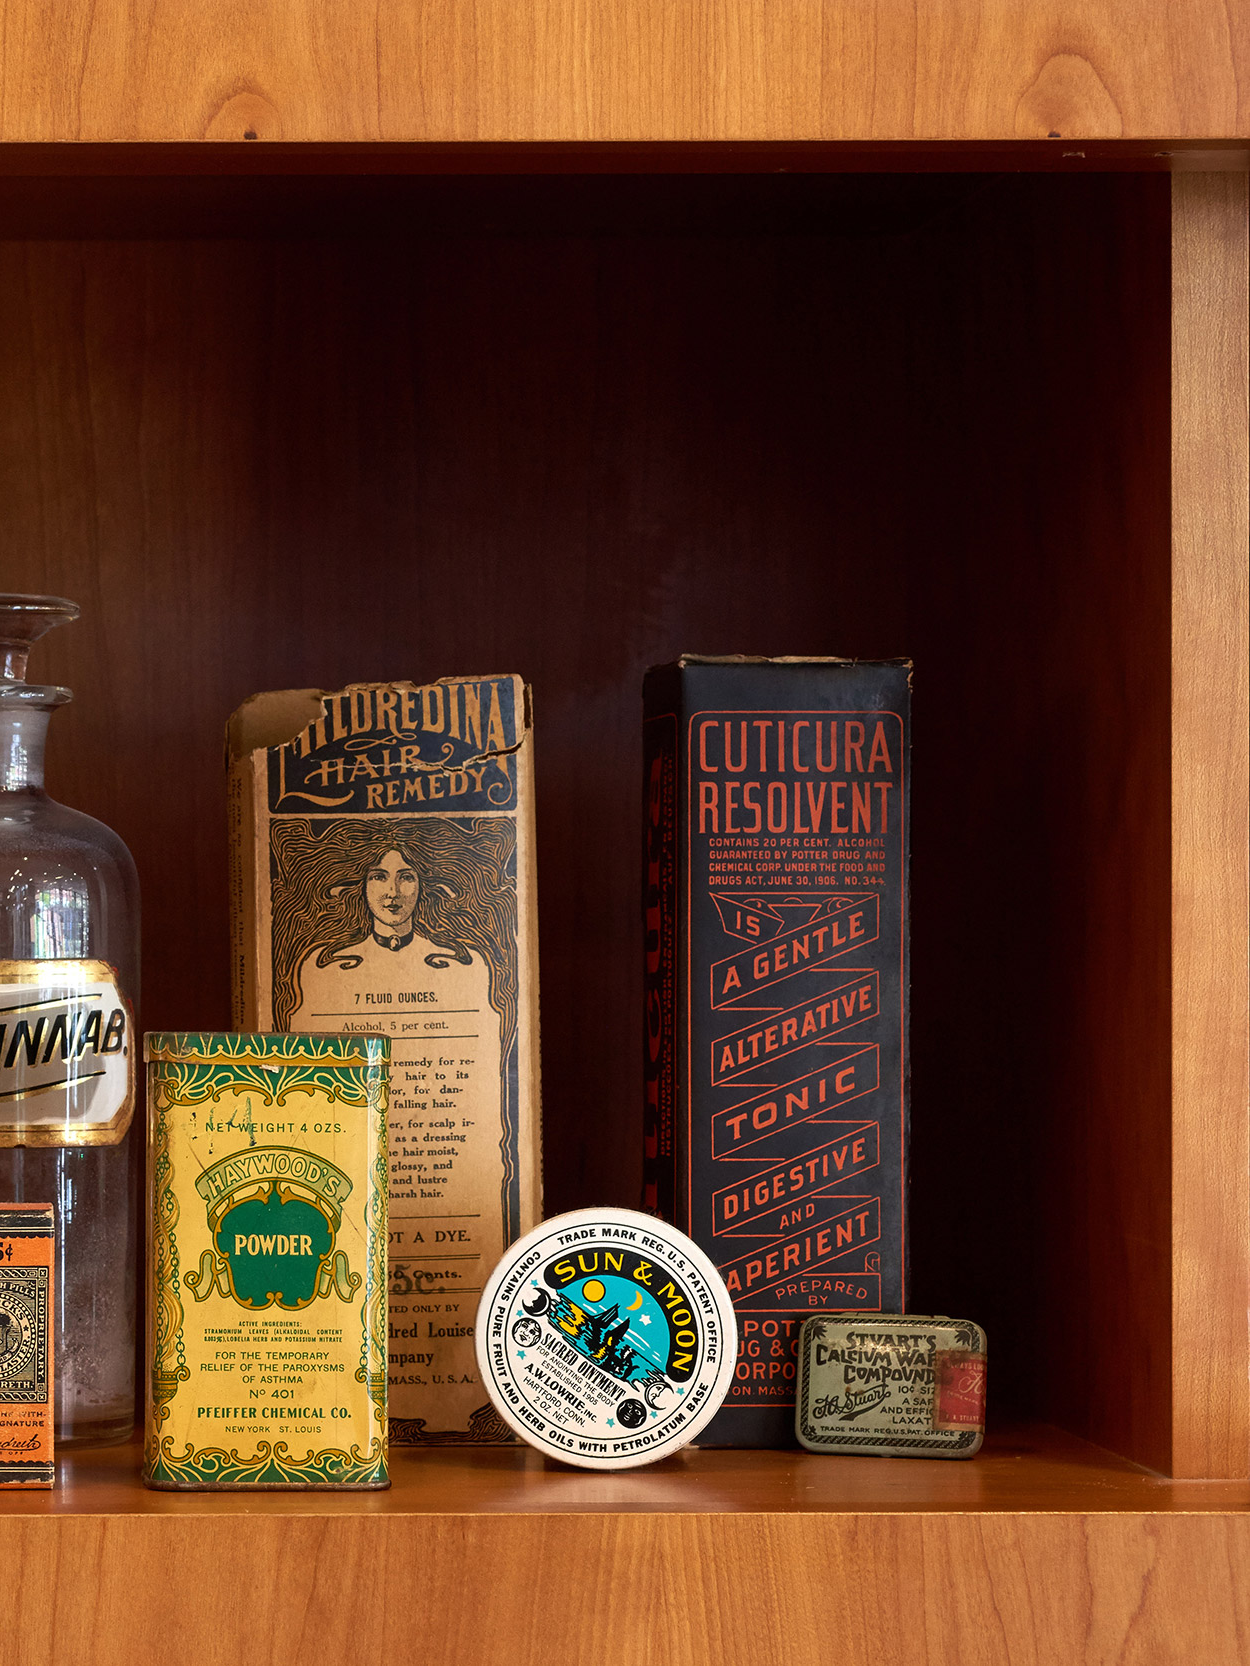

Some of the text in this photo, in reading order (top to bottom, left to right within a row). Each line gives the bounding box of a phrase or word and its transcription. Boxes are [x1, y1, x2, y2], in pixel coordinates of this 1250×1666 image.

[699, 720, 893, 773] CUTICURA
[304, 743, 455, 787] HAIR
[366, 766, 486, 810] REMEDY
[699, 781, 893, 834] RESOLVENT
[709, 850, 886, 860] GUARANTEED BY POTTER DRUG AND
[735, 911, 760, 937] IS
[721, 911, 865, 994] A GENTLE
[354, 992, 438, 1004] 7 FLUID OUNCES.
[342, 1020, 449, 1034] Alcohol, 5 per cent.
[719, 985, 872, 1073] ALTERATIVE
[393, 1057, 475, 1068] remedy for re-
[393, 1099, 457, 1110] falling hair.
[725, 1066, 855, 1140] TONIC
[205, 1122, 347, 1133] NET WEIGHT 4 OZS.
[205, 1153, 343, 1199] HAYWOOD'S
[723, 1137, 866, 1220] DIGESTIVE
[779, 1203, 816, 1229] AND
[235, 1234, 313, 1256] POWDER
[435, 1231, 471, 1242] DYE.
[726, 1211, 870, 1293] APERIENT
[9, 1282, 36, 1298] PILLS
[557, 1228, 717, 1363] TRADE MARK REG. U.S. PATENT OFFICE
[775, 1280, 868, 1300] PREPARED
[809, 1295, 828, 1305] BY
[553, 1252, 696, 1373] SUN & MOON
[428, 1322, 474, 1338] Louise
[215, 1352, 330, 1360] FOR THE TEMPORARY
[492, 1251, 709, 1453] CONTAINS PURE FRUIT AND HERB OILS WITH PETROLATUM BASE
[258, 1364, 279, 1372] THE
[283, 1364, 345, 1372] PAROXYSMS
[536, 1346, 615, 1407] FOR ANOINTING THE BODY
[541, 1333, 627, 1401] SACRED OINTMENT
[271, 1389, 294, 1399] 401
[541, 1360, 599, 1405] ESTABLISHED 1905
[198, 1407, 352, 1418] PFEIFFER CHEMICAL CO.
[523, 1376, 586, 1428] HARTFORD, CONN.
